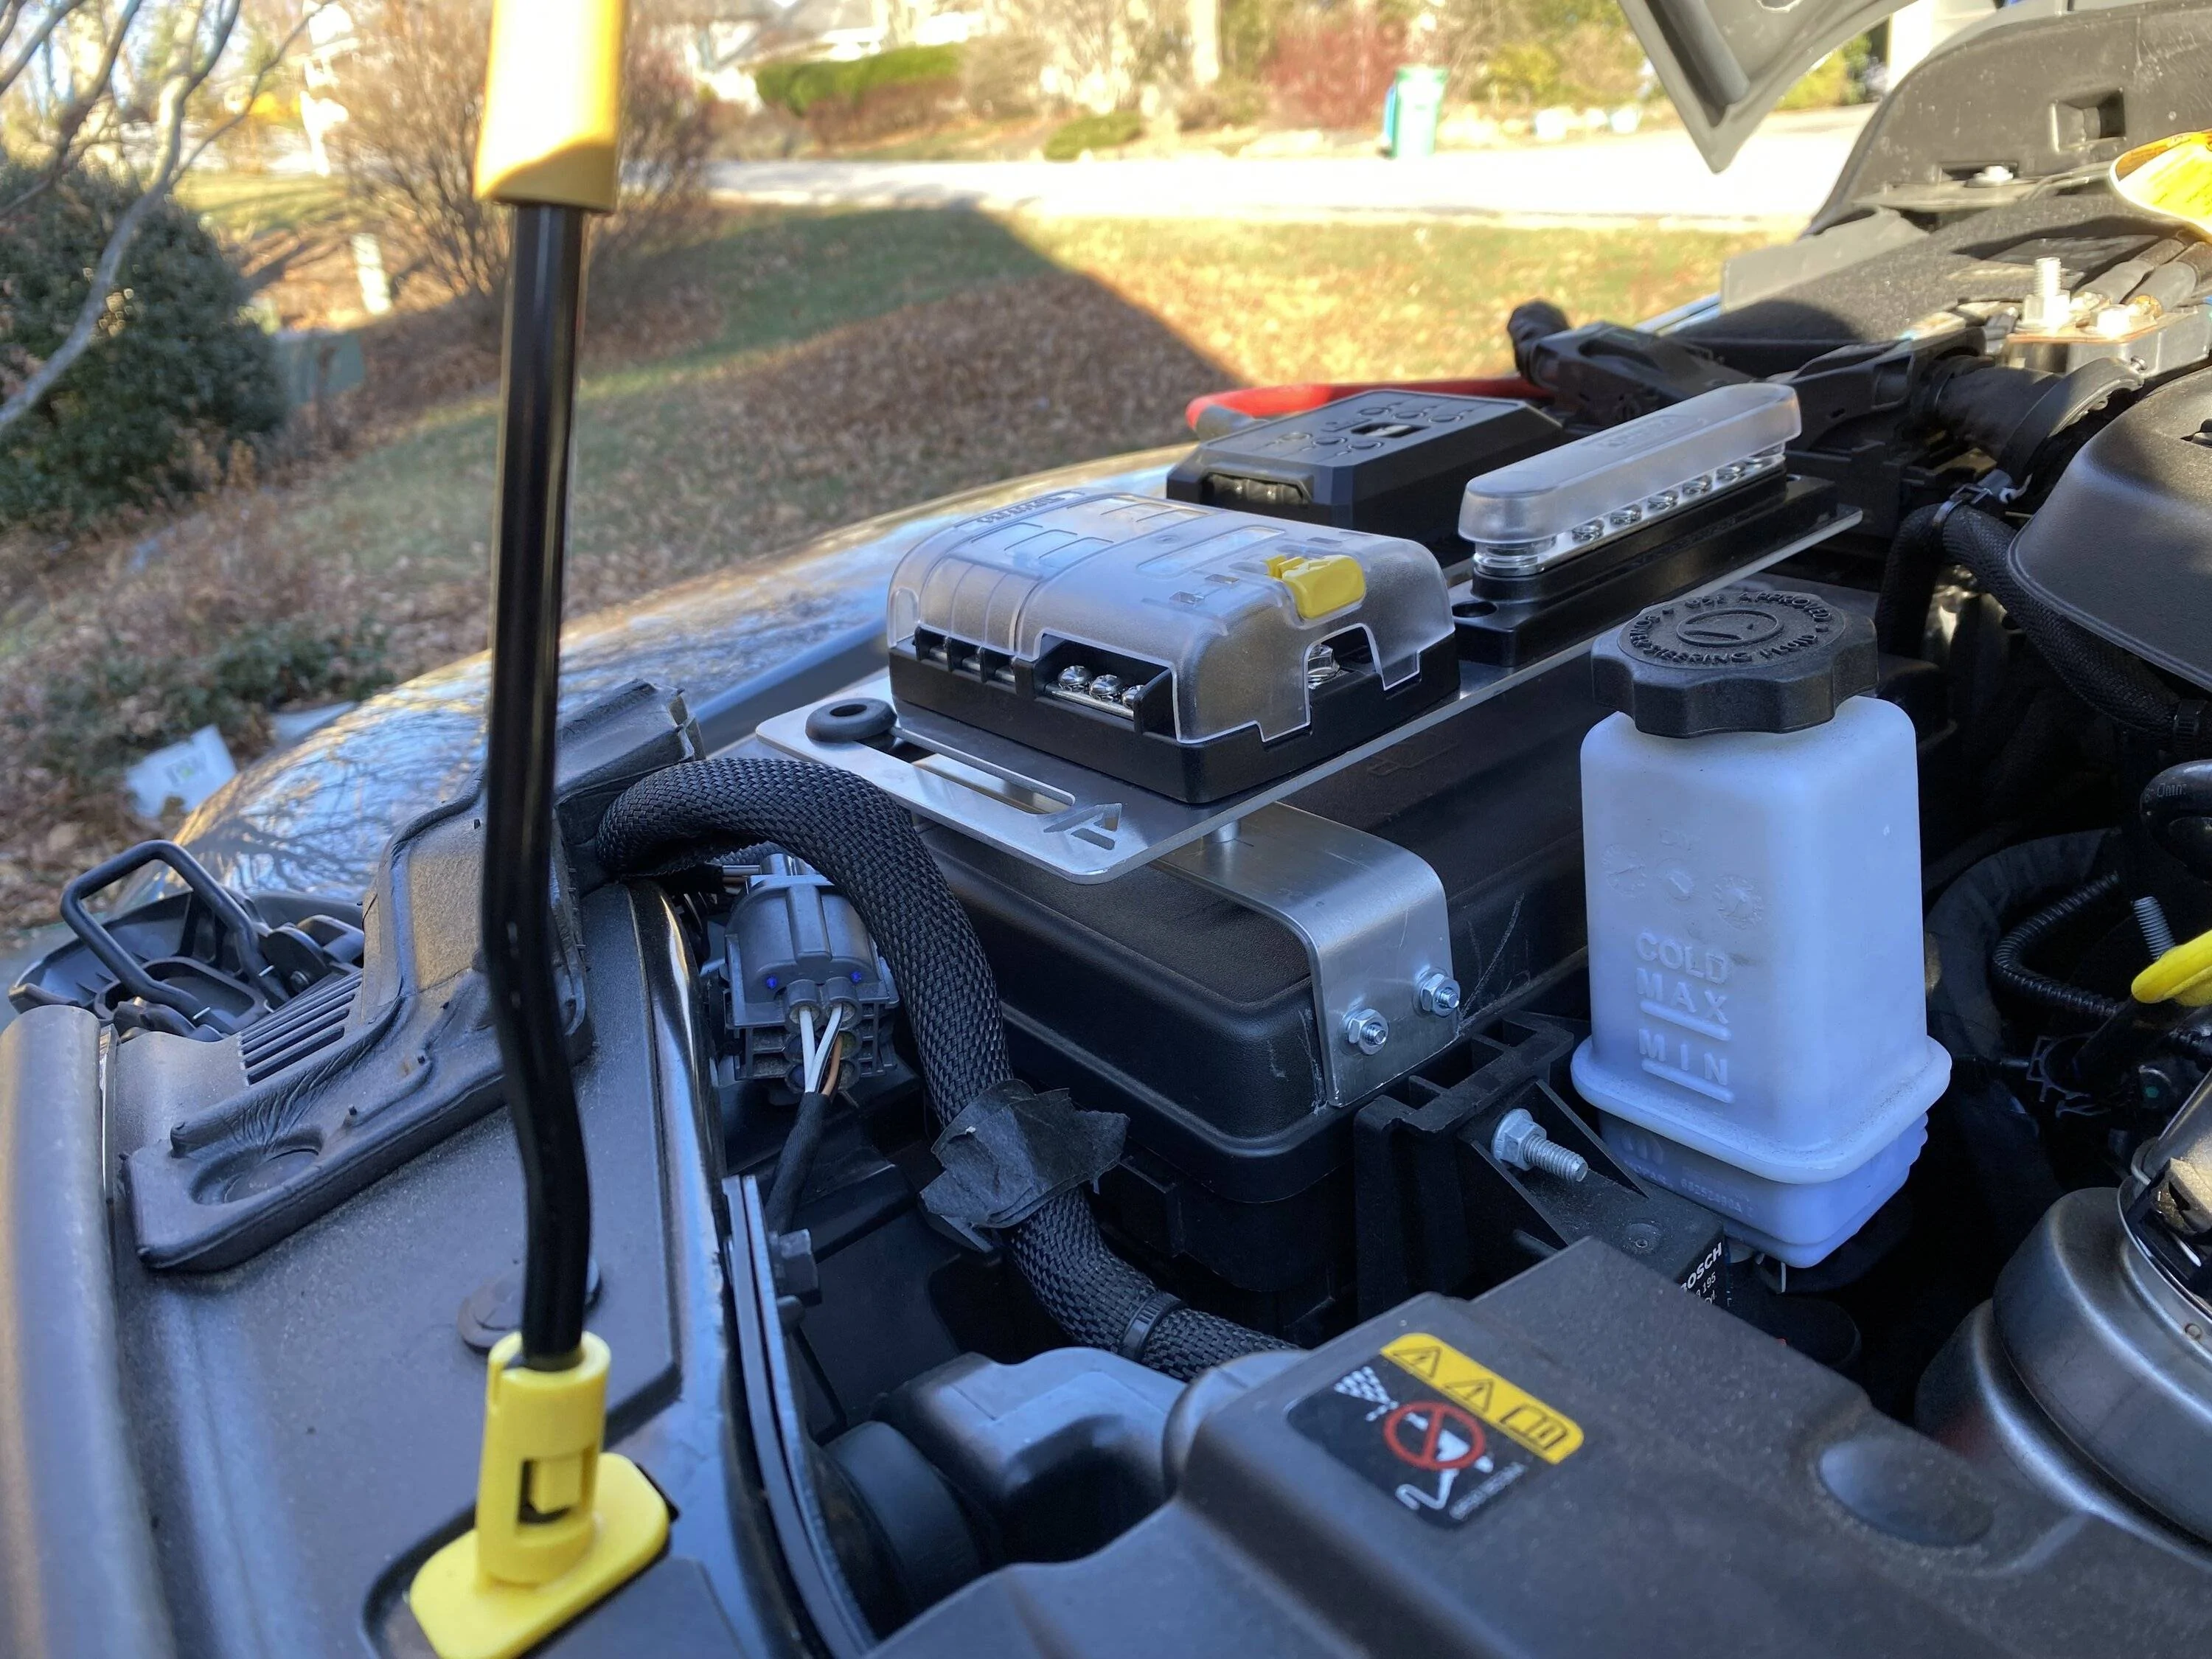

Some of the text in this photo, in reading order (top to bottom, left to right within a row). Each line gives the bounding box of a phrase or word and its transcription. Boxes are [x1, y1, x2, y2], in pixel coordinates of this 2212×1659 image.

[1739, 590, 1832, 623] APPROVED
[1636, 931, 1729, 984] COLD
[1636, 967, 1730, 1026] MAX
[1638, 1027, 1729, 1086] MIN
[1703, 1271, 1717, 1294] 195
